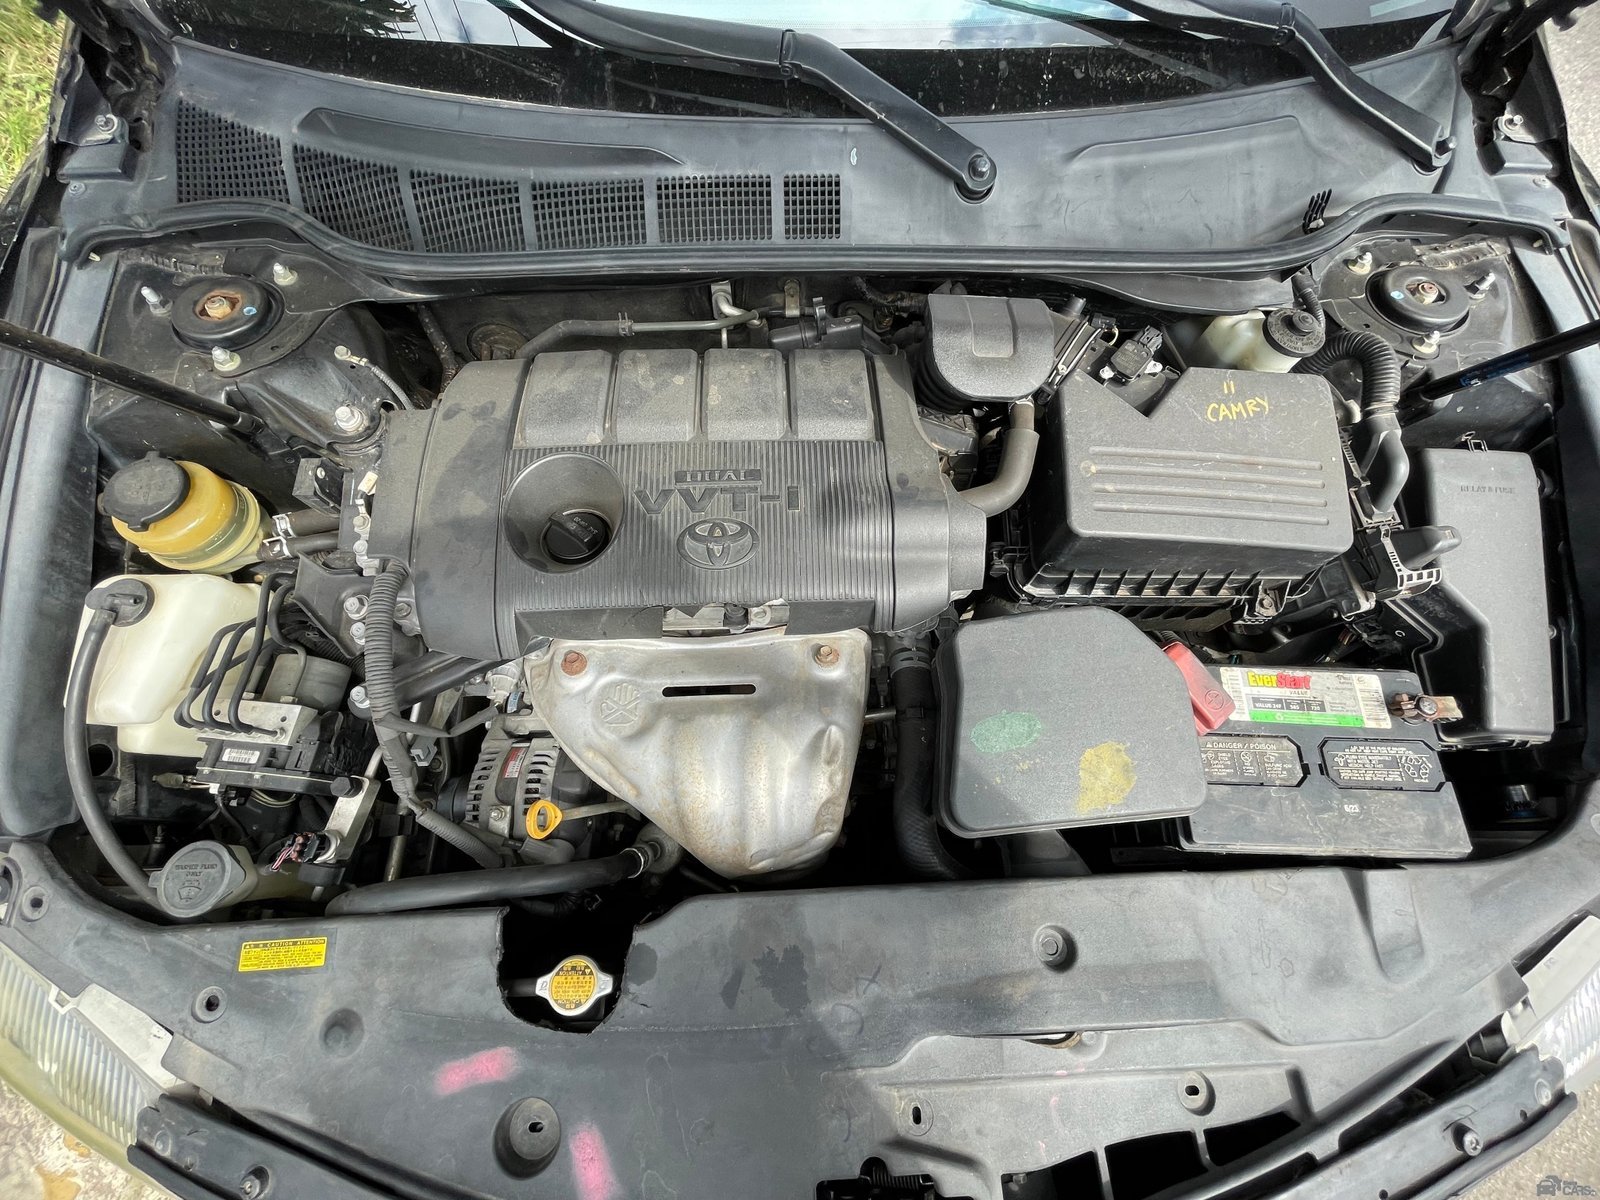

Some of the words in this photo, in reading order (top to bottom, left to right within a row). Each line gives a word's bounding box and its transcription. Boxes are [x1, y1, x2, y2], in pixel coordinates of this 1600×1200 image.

[1207, 397, 1269, 421] CAMRY
[684, 470, 748, 482] DUAL
[1247, 671, 1312, 690] EverStart
[1254, 701, 1272, 709] VALUE
